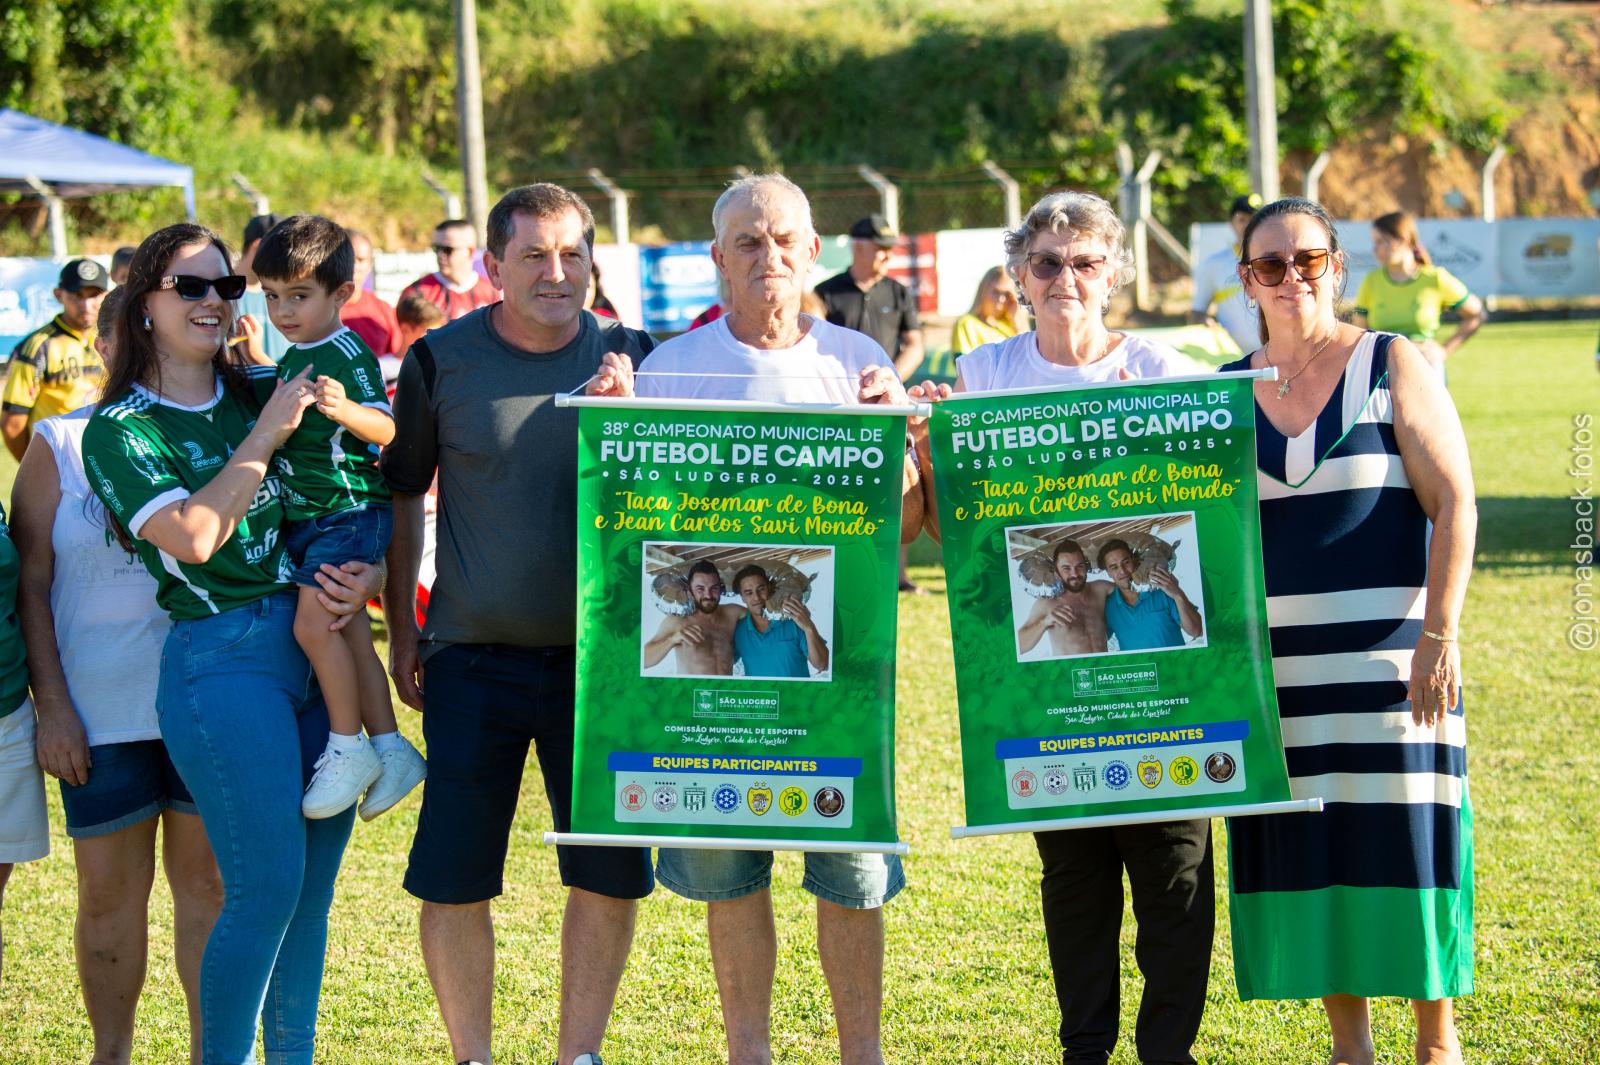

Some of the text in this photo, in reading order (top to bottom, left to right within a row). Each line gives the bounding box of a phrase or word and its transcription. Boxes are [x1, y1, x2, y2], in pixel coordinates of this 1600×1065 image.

[981, 401, 1102, 425] CAMPEONATO
[1107, 393, 1202, 413] MUNICIPAL
[1207, 391, 1230, 405] DE
[633, 422, 756, 440] CAMPEONATO
[760, 425, 856, 442] MUNICIPAL
[860, 428, 883, 442] DE
[952, 408, 1233, 454] FUTEBOL DE CAMPO
[600, 440, 884, 469] FUTEBOL DE CAMPO
[973, 455, 1013, 470] SÃO
[1028, 445, 1128, 465] LUDGERO
[1164, 438, 1215, 453] 2025
[619, 467, 660, 481] SÃO
[675, 470, 777, 484] LUDGERO
[813, 474, 864, 486] 2025
[1032, 471, 1127, 494] Josemar
[1131, 464, 1162, 485] de
[1167, 462, 1223, 482] Bona
[676, 492, 773, 513] Josemar
[776, 494, 807, 514] de
[812, 495, 869, 515] Bona
[955, 506, 969, 521] e
[973, 501, 1024, 520] Jean
[1029, 492, 1102, 515] Carlos
[1107, 487, 1157, 508] Savi
[594, 514, 608, 529] e
[613, 511, 665, 531] Jean
[670, 512, 744, 533] Carlos
[750, 515, 800, 534] Savi
[1097, 671, 1155, 682] SÃO LUDGERO
[738, 698, 777, 706] LUDGERO
[1046, 697, 1190, 715] COMISSÃO MUNICIPAL DE ESPORTES
[664, 724, 707, 733] COMISSÃO
[709, 726, 753, 734] MUNICIPAL
[767, 728, 807, 736] ESPORTES
[1039, 728, 1204, 752] EQUIPES PARTICIPANTES
[652, 756, 817, 772] EQUIPES PARTICIPANTES
